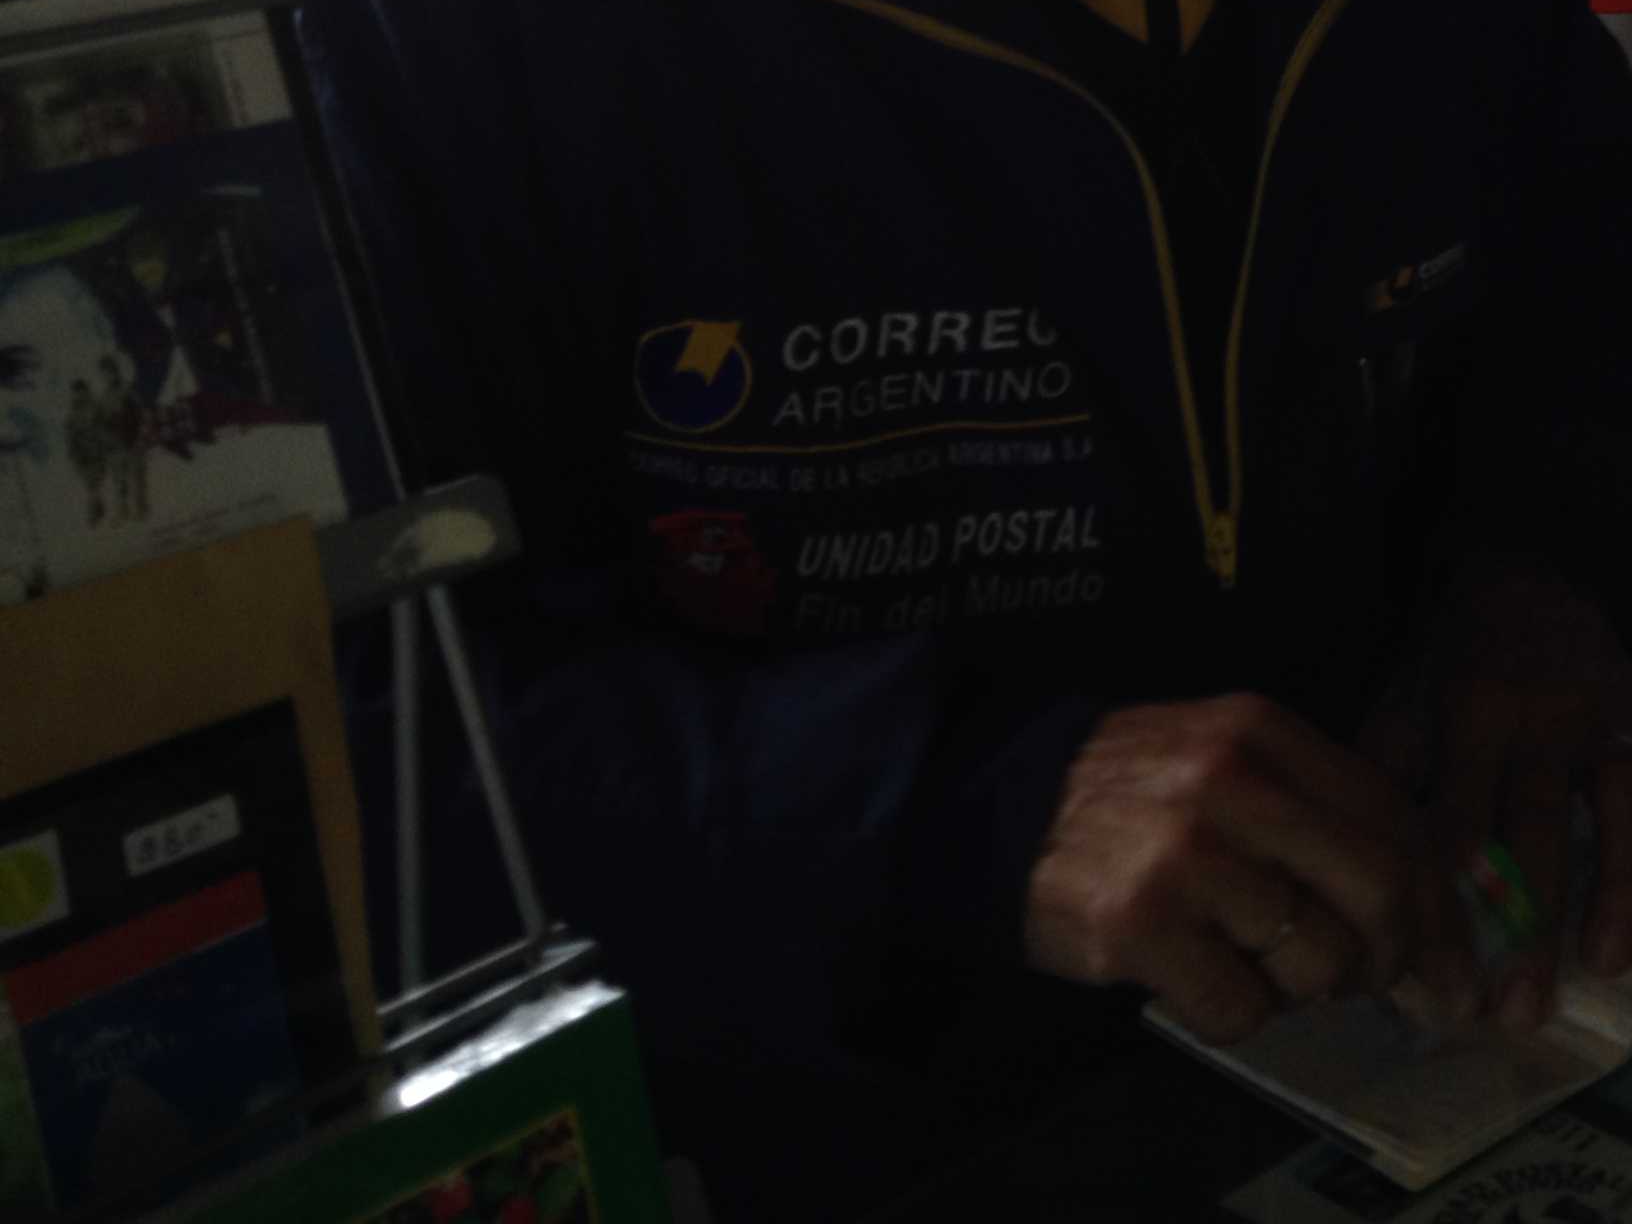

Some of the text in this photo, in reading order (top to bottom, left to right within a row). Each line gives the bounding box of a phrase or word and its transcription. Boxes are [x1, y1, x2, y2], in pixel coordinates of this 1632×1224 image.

[772, 361, 1073, 427] ARGENTINO
[796, 505, 1102, 581] UNIDAD POSTAL
[794, 568, 1106, 633] Fin del Mundo
